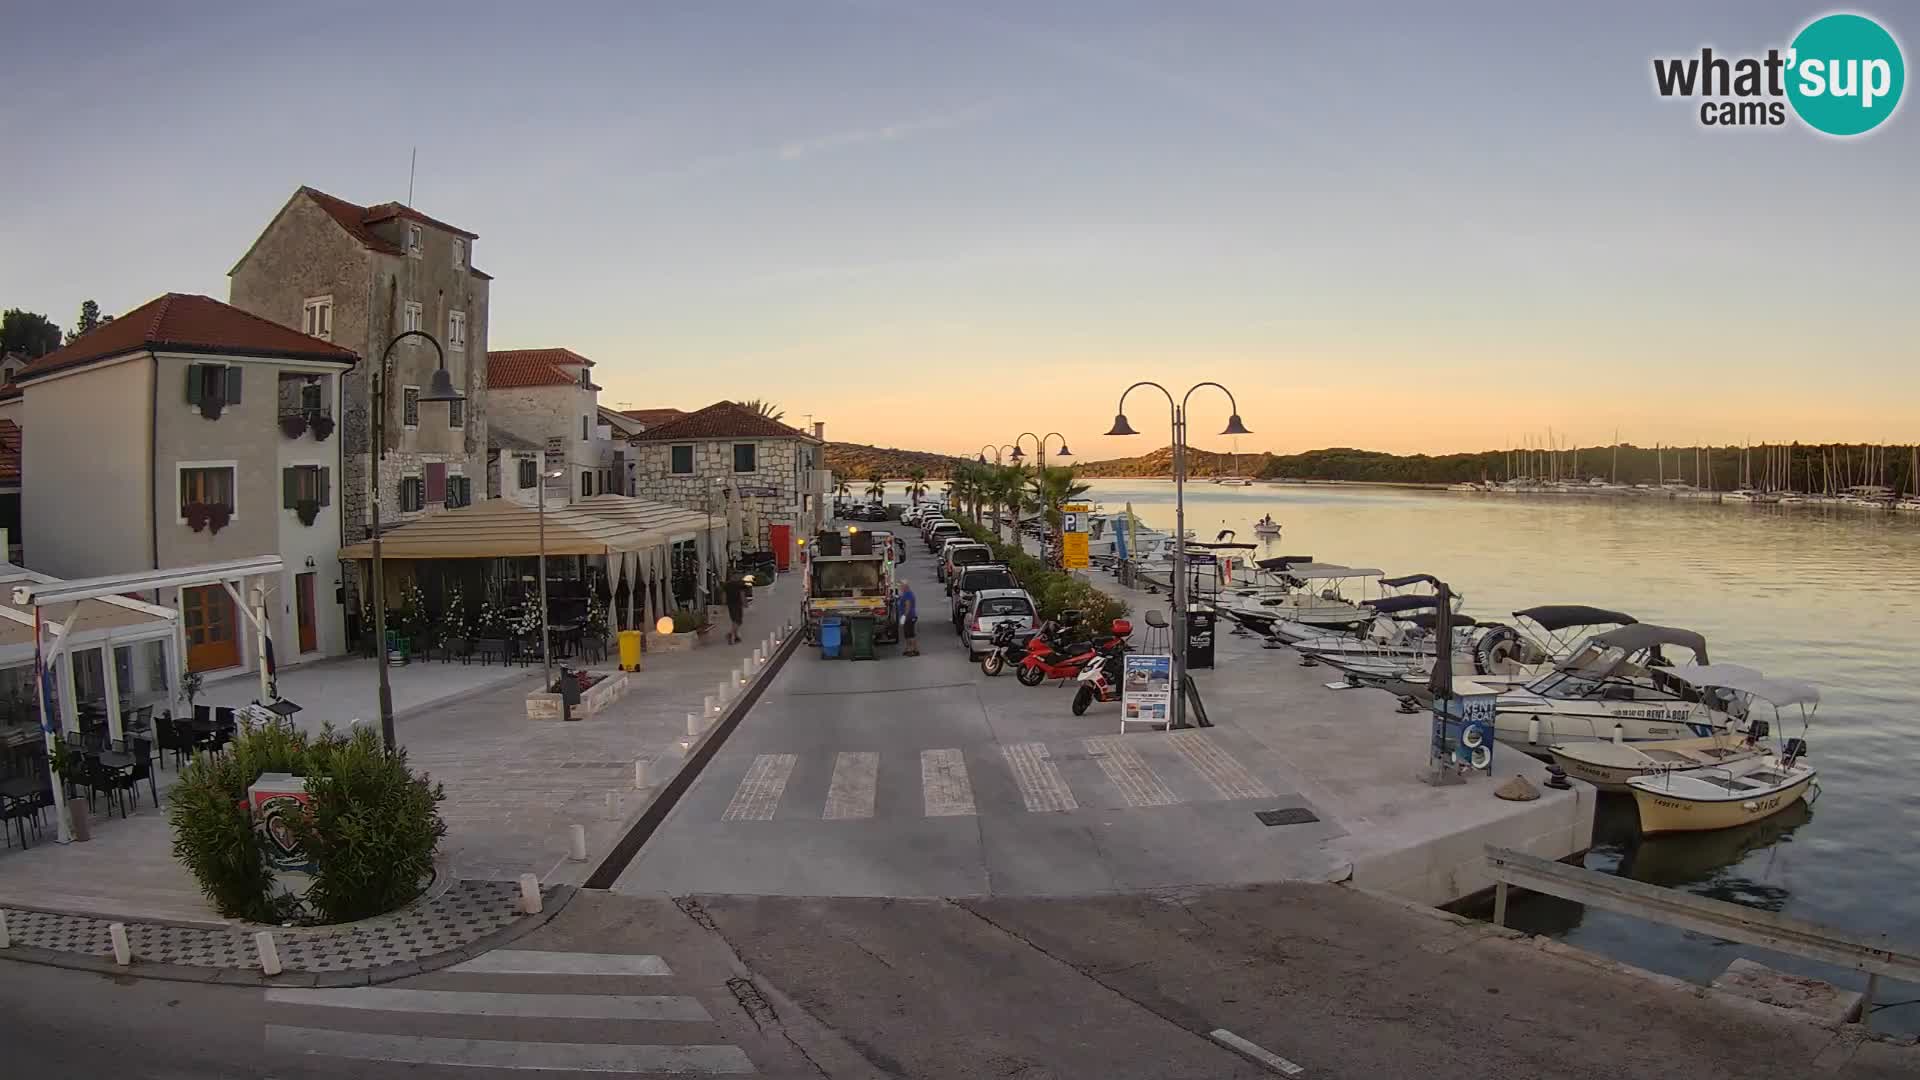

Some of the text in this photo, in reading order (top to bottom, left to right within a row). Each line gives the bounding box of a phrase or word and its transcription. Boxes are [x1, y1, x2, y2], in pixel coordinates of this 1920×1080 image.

[1065, 514, 1075, 531] P
[1463, 702, 1494, 713] RENT
[1463, 712, 1494, 721] A BOAT
[1646, 709, 1665, 719] RENT
[1665, 710, 1671, 719] A
[1671, 709, 1690, 721] BOAT
